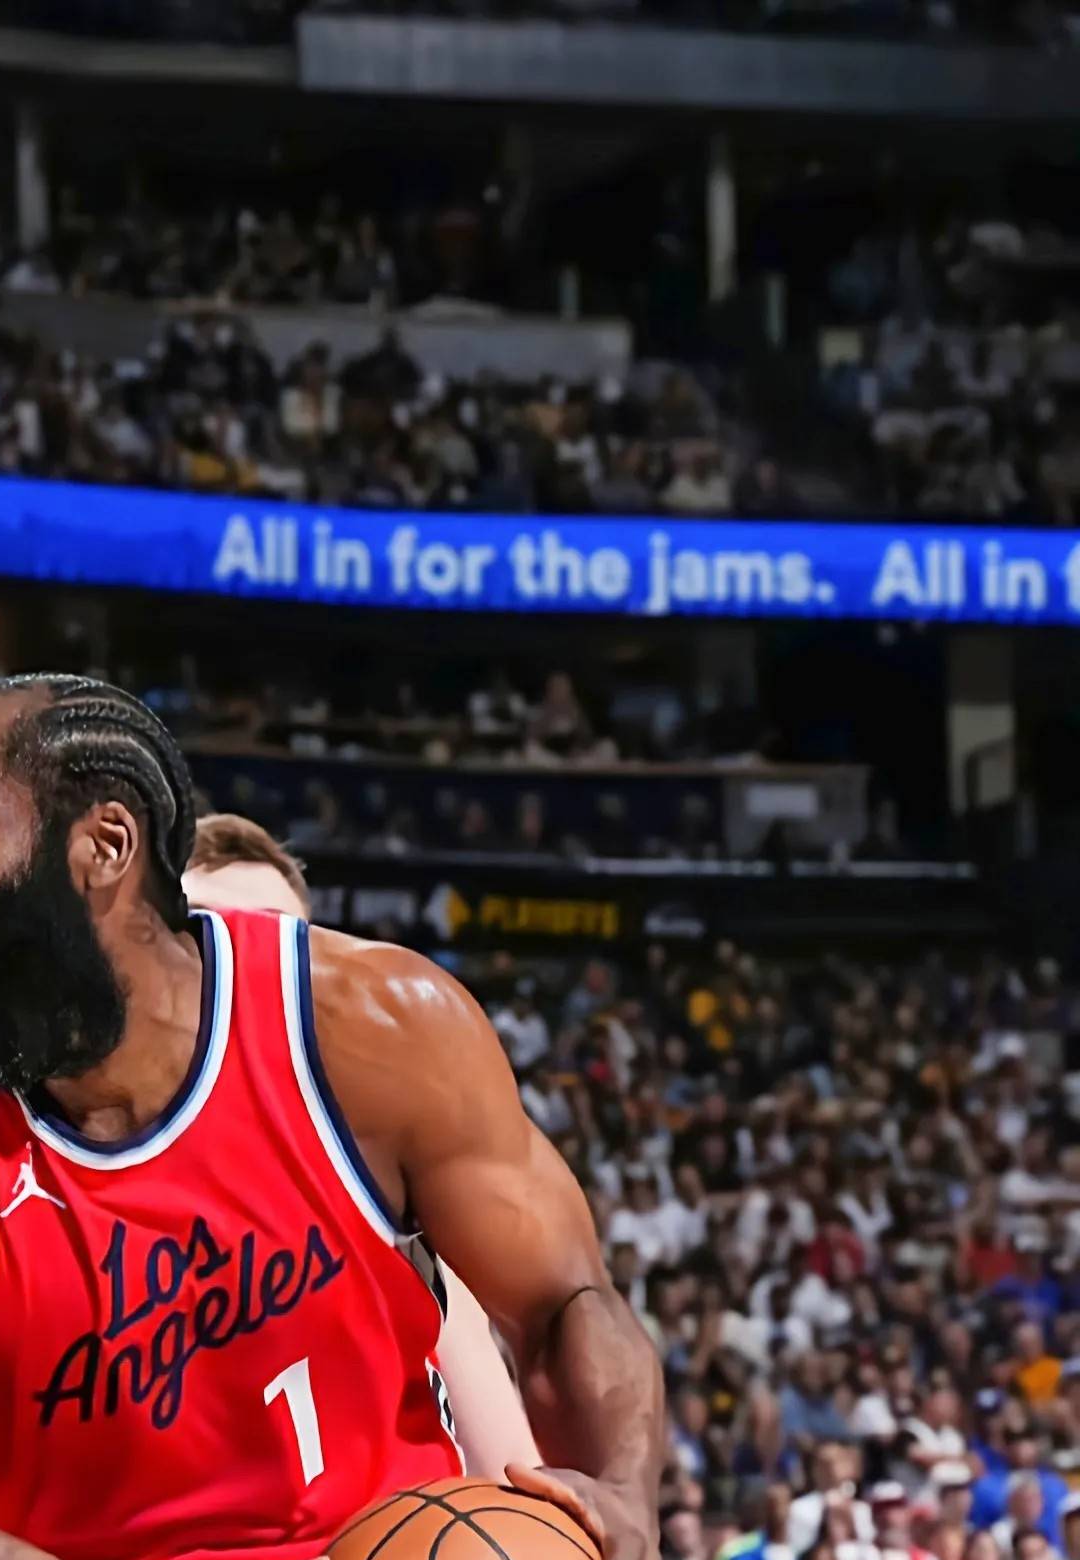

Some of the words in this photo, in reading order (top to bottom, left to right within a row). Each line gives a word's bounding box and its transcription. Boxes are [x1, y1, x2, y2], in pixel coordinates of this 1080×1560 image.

[214, 514, 297, 586] All
[314, 518, 371, 591] in
[387, 524, 496, 597] for
[509, 529, 632, 600] the
[643, 532, 837, 616] jams.
[872, 539, 965, 608] All
[984, 541, 1047, 611] in
[33, 1223, 345, 1430] Angeles
[101, 1215, 232, 1341] Los
[263, 1356, 325, 1487] 1
